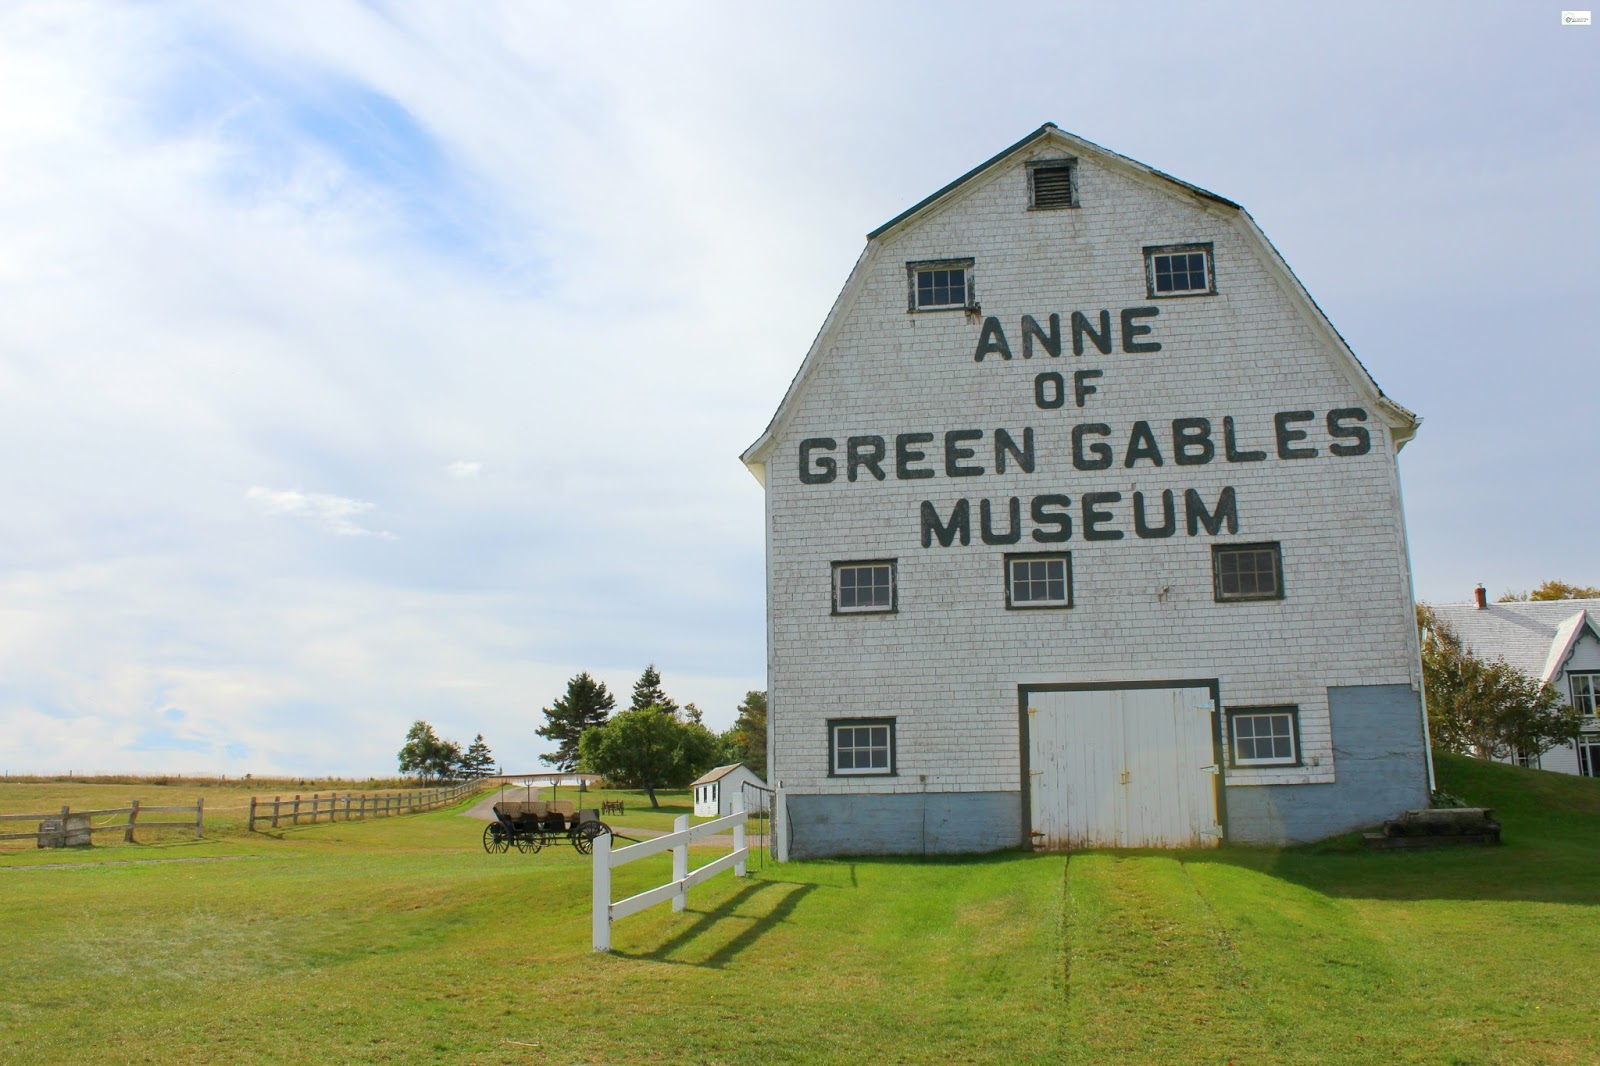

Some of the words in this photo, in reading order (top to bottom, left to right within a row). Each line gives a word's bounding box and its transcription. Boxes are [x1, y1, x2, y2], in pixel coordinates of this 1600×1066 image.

[973, 306, 1163, 363] ANNE
[1034, 369, 1104, 410] OF
[798, 426, 1036, 486] GREEN
[1071, 407, 1371, 472] GABLES
[920, 485, 1239, 549] MUSEUM
